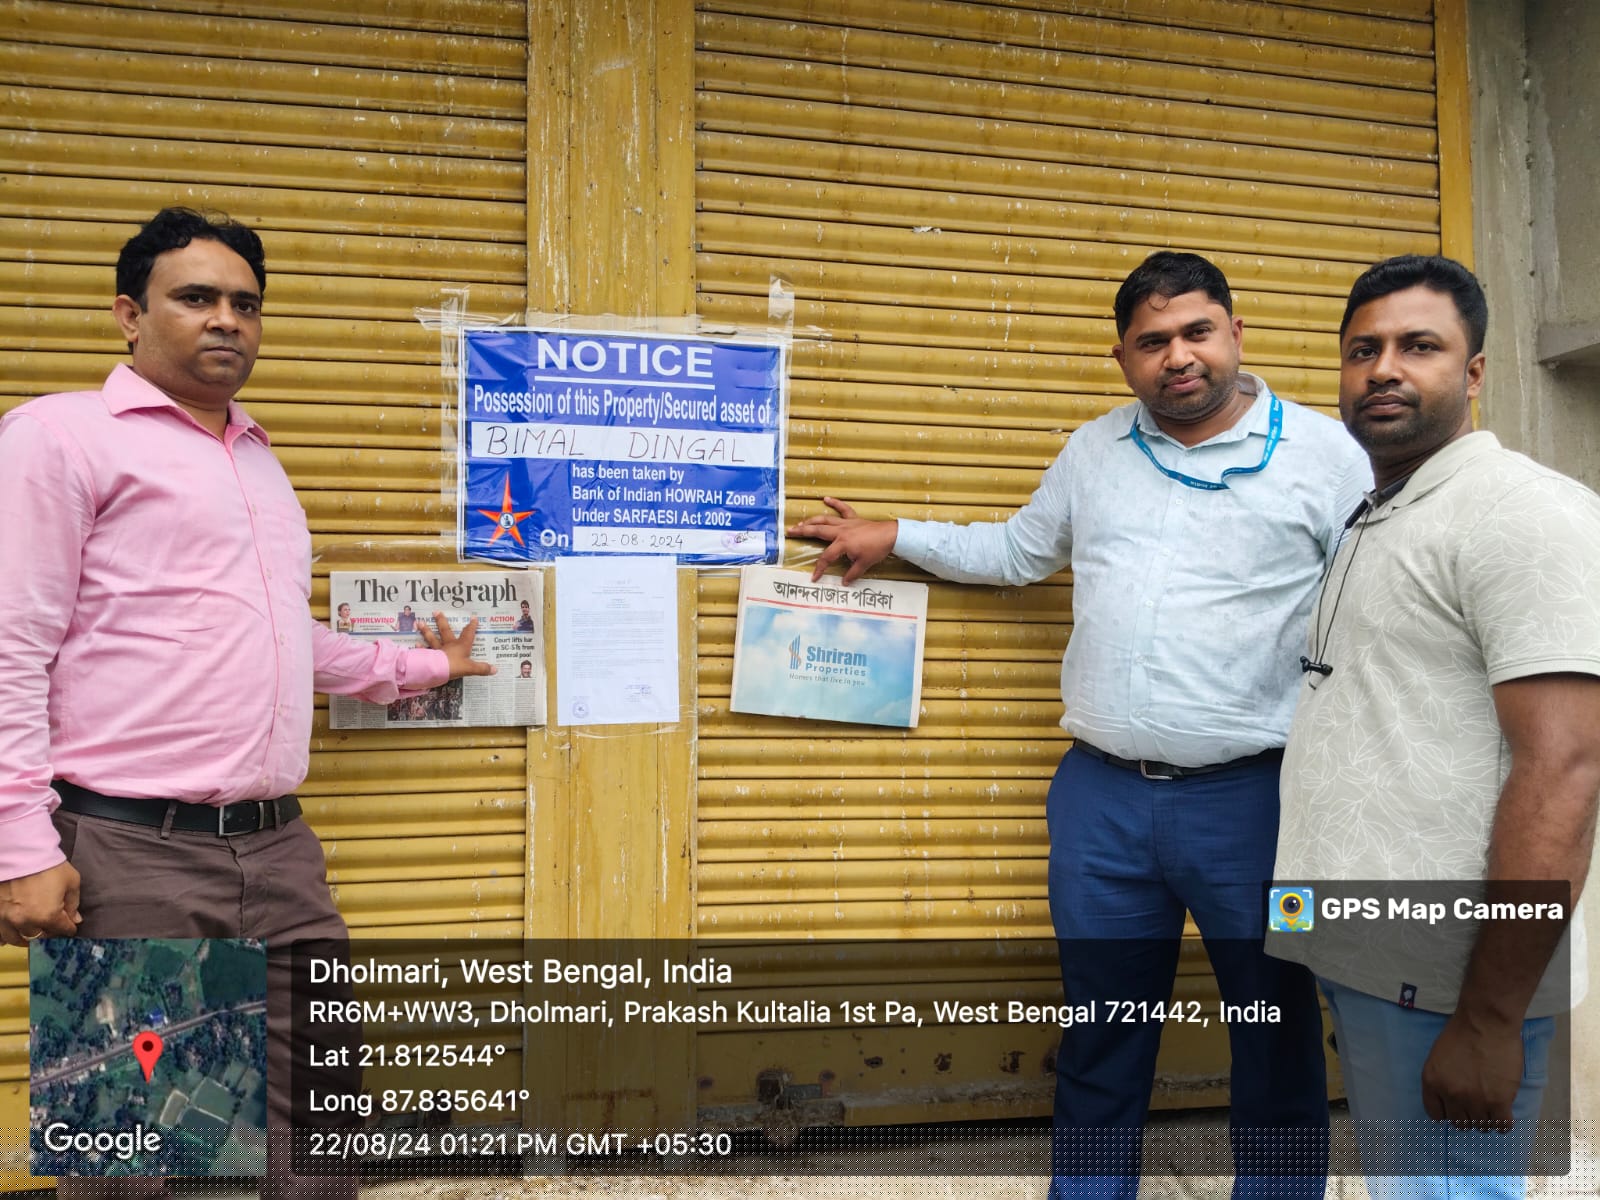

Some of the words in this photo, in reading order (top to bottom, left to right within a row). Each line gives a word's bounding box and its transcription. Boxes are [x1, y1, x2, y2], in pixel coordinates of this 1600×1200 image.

[537, 338, 714, 379] NOTICE
[474, 384, 553, 414] Possession
[557, 387, 572, 415] of
[575, 388, 600, 416] this
[603, 389, 717, 425] Property/Secured
[720, 398, 755, 424] asset
[758, 398, 771, 424] of
[486, 425, 585, 456] BIMAL
[627, 431, 745, 462] DINGAL
[572, 463, 595, 478] has
[598, 464, 629, 479] been
[632, 465, 666, 480] taken
[670, 466, 685, 484] by
[572, 485, 604, 500] Bank
[608, 486, 621, 501] of
[623, 487, 662, 502] Indian
[665, 488, 723, 505] HOWRAH
[725, 490, 756, 506] Zone
[572, 507, 610, 523] Under
[613, 508, 678, 525] SARFAESI
[681, 509, 702, 525] Act
[704, 511, 732, 527] 2002
[540, 528, 569, 548] On
[354, 578, 399, 603] The
[405, 578, 517, 608] Telegraph
[773, 581, 850, 606] আনন্দবাজার
[851, 587, 894, 611] পত্রিকা
[806, 646, 867, 667] Shriram
[805, 662, 867, 677] Properties
